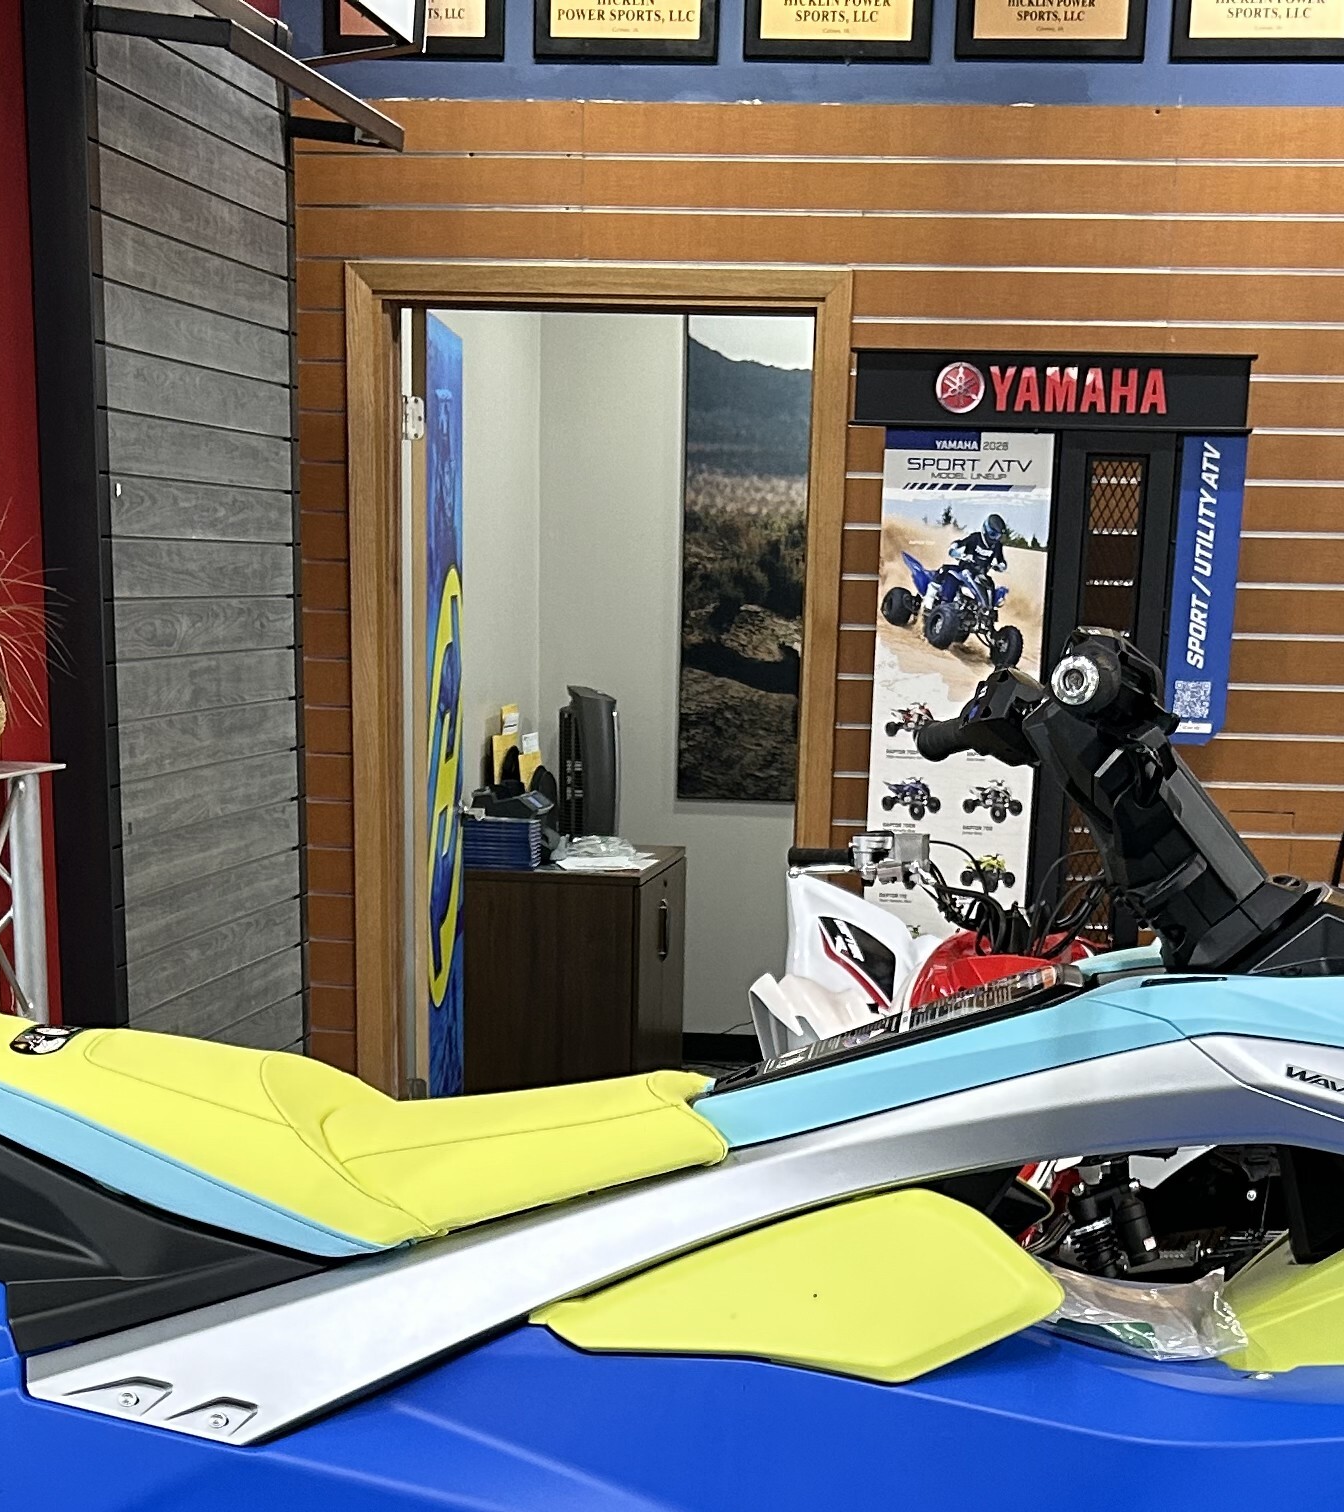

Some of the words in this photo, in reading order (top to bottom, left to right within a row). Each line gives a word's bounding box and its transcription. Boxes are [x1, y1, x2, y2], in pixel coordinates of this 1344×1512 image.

[557, 9, 605, 21] POWER
[609, 9, 665, 24] SPORTS,
[669, 10, 696, 22] LLC
[795, 10, 849, 24] SPORTS,
[853, 10, 879, 23] LLC
[1017, 11, 1061, 23] SPORTS,
[1063, 11, 1086, 21] LLC
[1227, 7, 1282, 20] SPORTS,
[1286, 7, 1312, 19] LLC
[989, 365, 1167, 415] YAMAHA
[935, 440, 979, 450] YAMAHA
[907, 457, 981, 472] SPORT
[988, 459, 1033, 472] ATV
[1200, 441, 1222, 490] ATV
[931, 472, 967, 480] MODEL
[1194, 488, 1217, 577] UTILITY
[1186, 593, 1210, 670] SPORT
